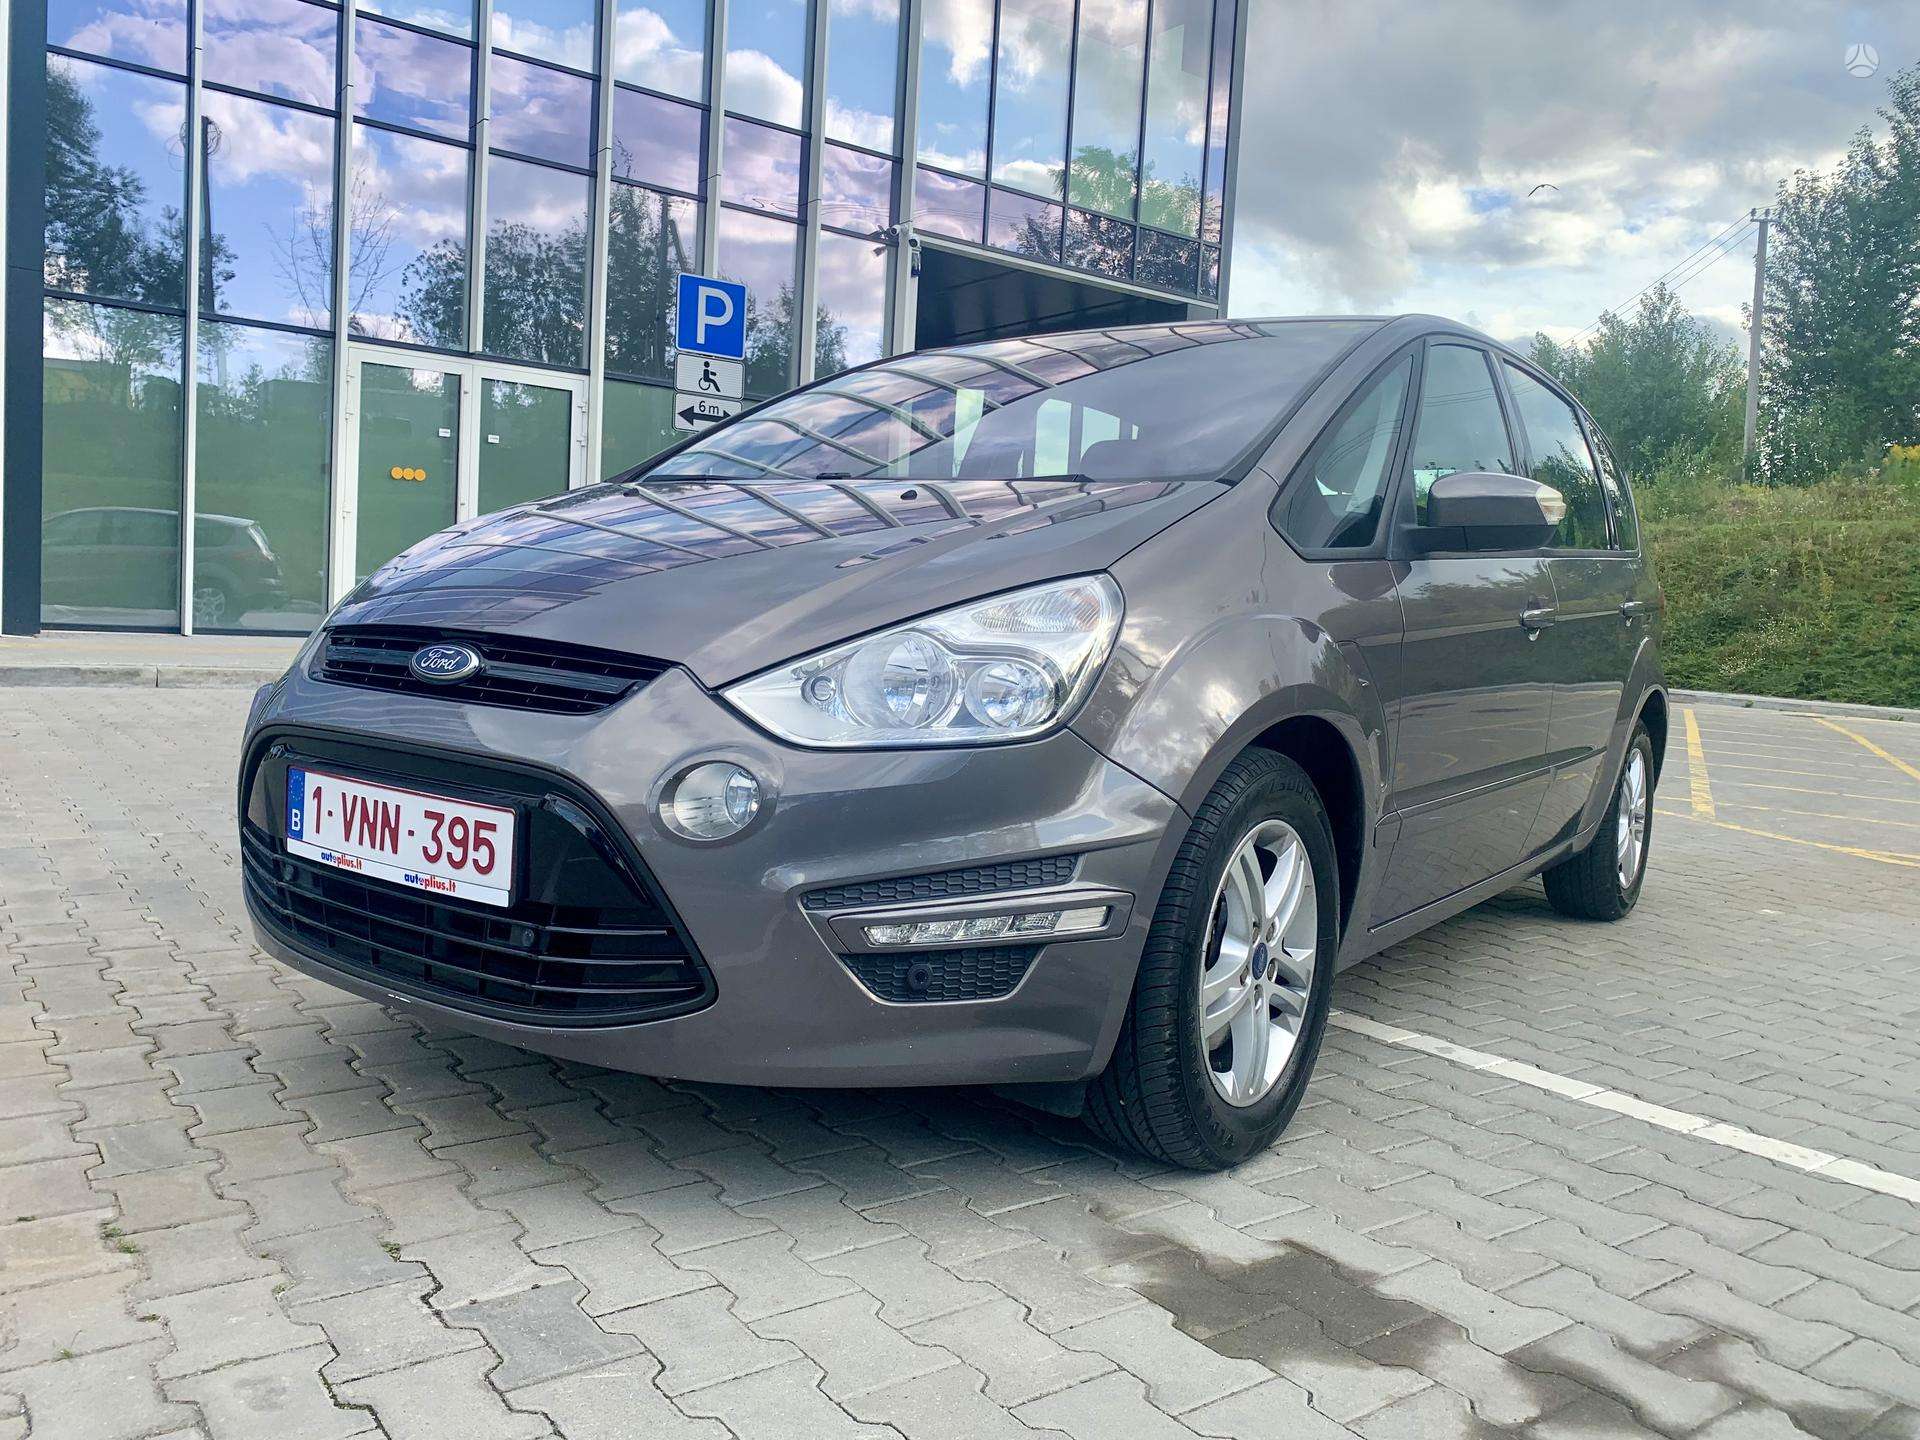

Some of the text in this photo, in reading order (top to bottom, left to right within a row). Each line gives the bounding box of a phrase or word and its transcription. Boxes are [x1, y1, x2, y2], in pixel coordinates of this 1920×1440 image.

[697, 285, 734, 345] P
[698, 400, 720, 416] 6 m
[421, 648, 462, 670] Ford
[291, 809, 301, 831] B
[320, 850, 362, 870] autoplius.lt
[403, 872, 457, 893] autoplius.lt
